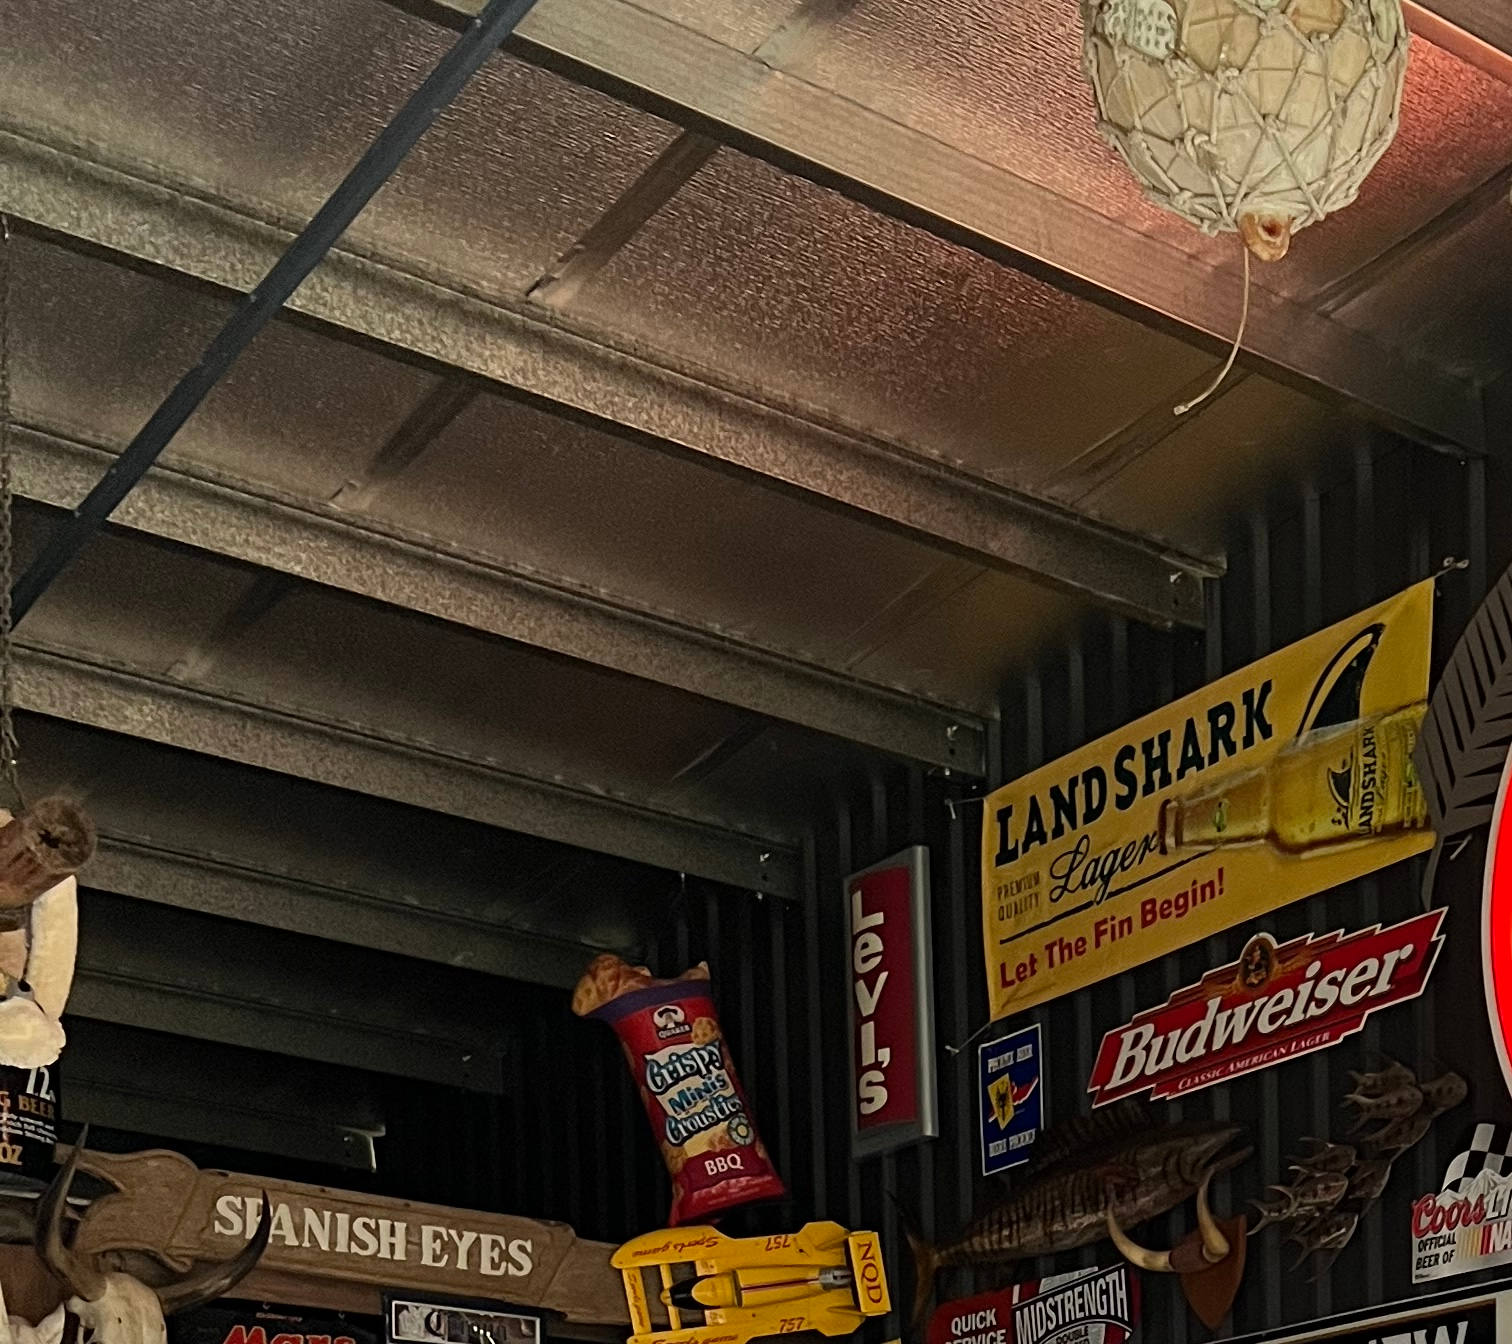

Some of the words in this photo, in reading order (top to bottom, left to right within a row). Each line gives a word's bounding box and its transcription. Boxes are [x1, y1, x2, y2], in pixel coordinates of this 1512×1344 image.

[997, 871, 1042, 900] PREMIUM
[1050, 831, 1160, 905] Lager
[997, 892, 1042, 922] QUALITY
[1000, 953, 1037, 989] Let
[1044, 931, 1087, 970] The
[1094, 911, 1132, 949] Fin
[1140, 867, 1224, 930] Begin!
[1105, 944, 1414, 1092] Budweiser
[646, 1042, 722, 1094] Crispy
[1227, 1046, 1286, 1076] AMERICAN
[1289, 1032, 1331, 1054] LAGER
[705, 1153, 744, 1175] BBQ
[214, 1196, 407, 1261] SPANISH
[421, 1224, 534, 1278] EYES
[1411, 1193, 1487, 1239] Coors
[1416, 1252, 1440, 1271] BEER
[1442, 1249, 1456, 1264] OF
[1417, 1232, 1457, 1253] OFFICIAL
[951, 1308, 997, 1337] QUICK
